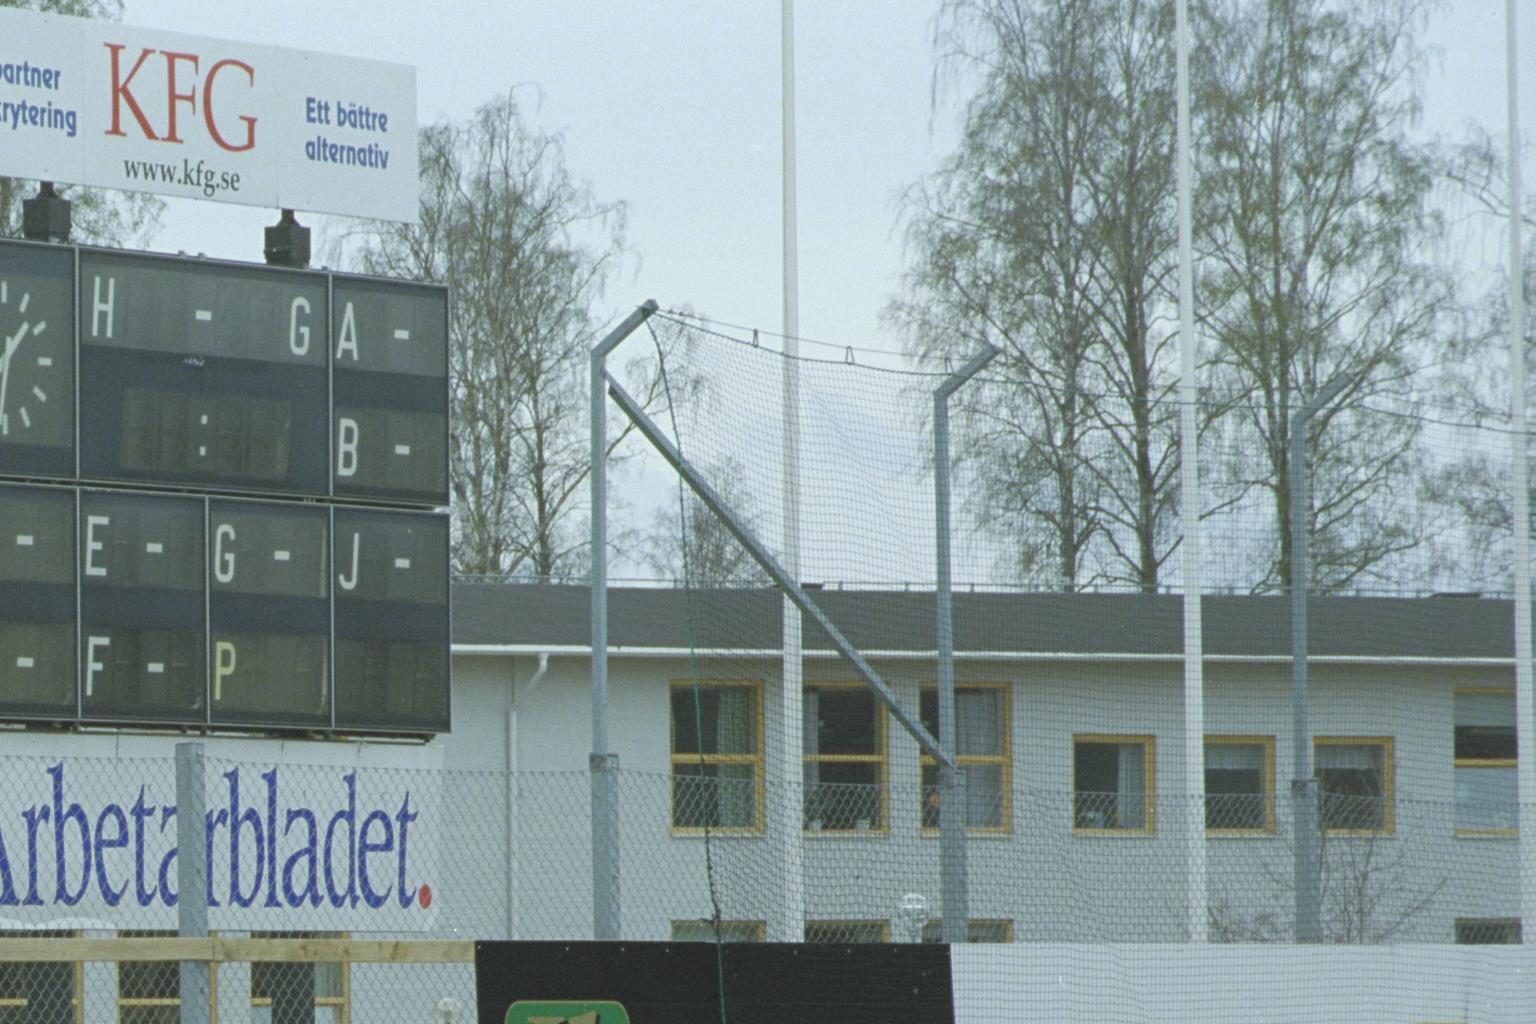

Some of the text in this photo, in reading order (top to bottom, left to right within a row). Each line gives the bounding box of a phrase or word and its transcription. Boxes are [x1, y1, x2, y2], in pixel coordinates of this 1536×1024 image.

[104, 43, 258, 152] KFG
[306, 97, 388, 133] Ett bättre
[124, 159, 241, 197] www.kfg.se
[305, 136, 389, 169] alternativ
[92, 277, 115, 338] H
[289, 297, 310, 355] G
[336, 302, 359, 361] A
[338, 418, 359, 476] B
[85, 516, 109, 576] E
[215, 524, 235, 583] G
[339, 533, 359, 590] J
[86, 637, 110, 696] F
[215, 642, 236, 700] P
